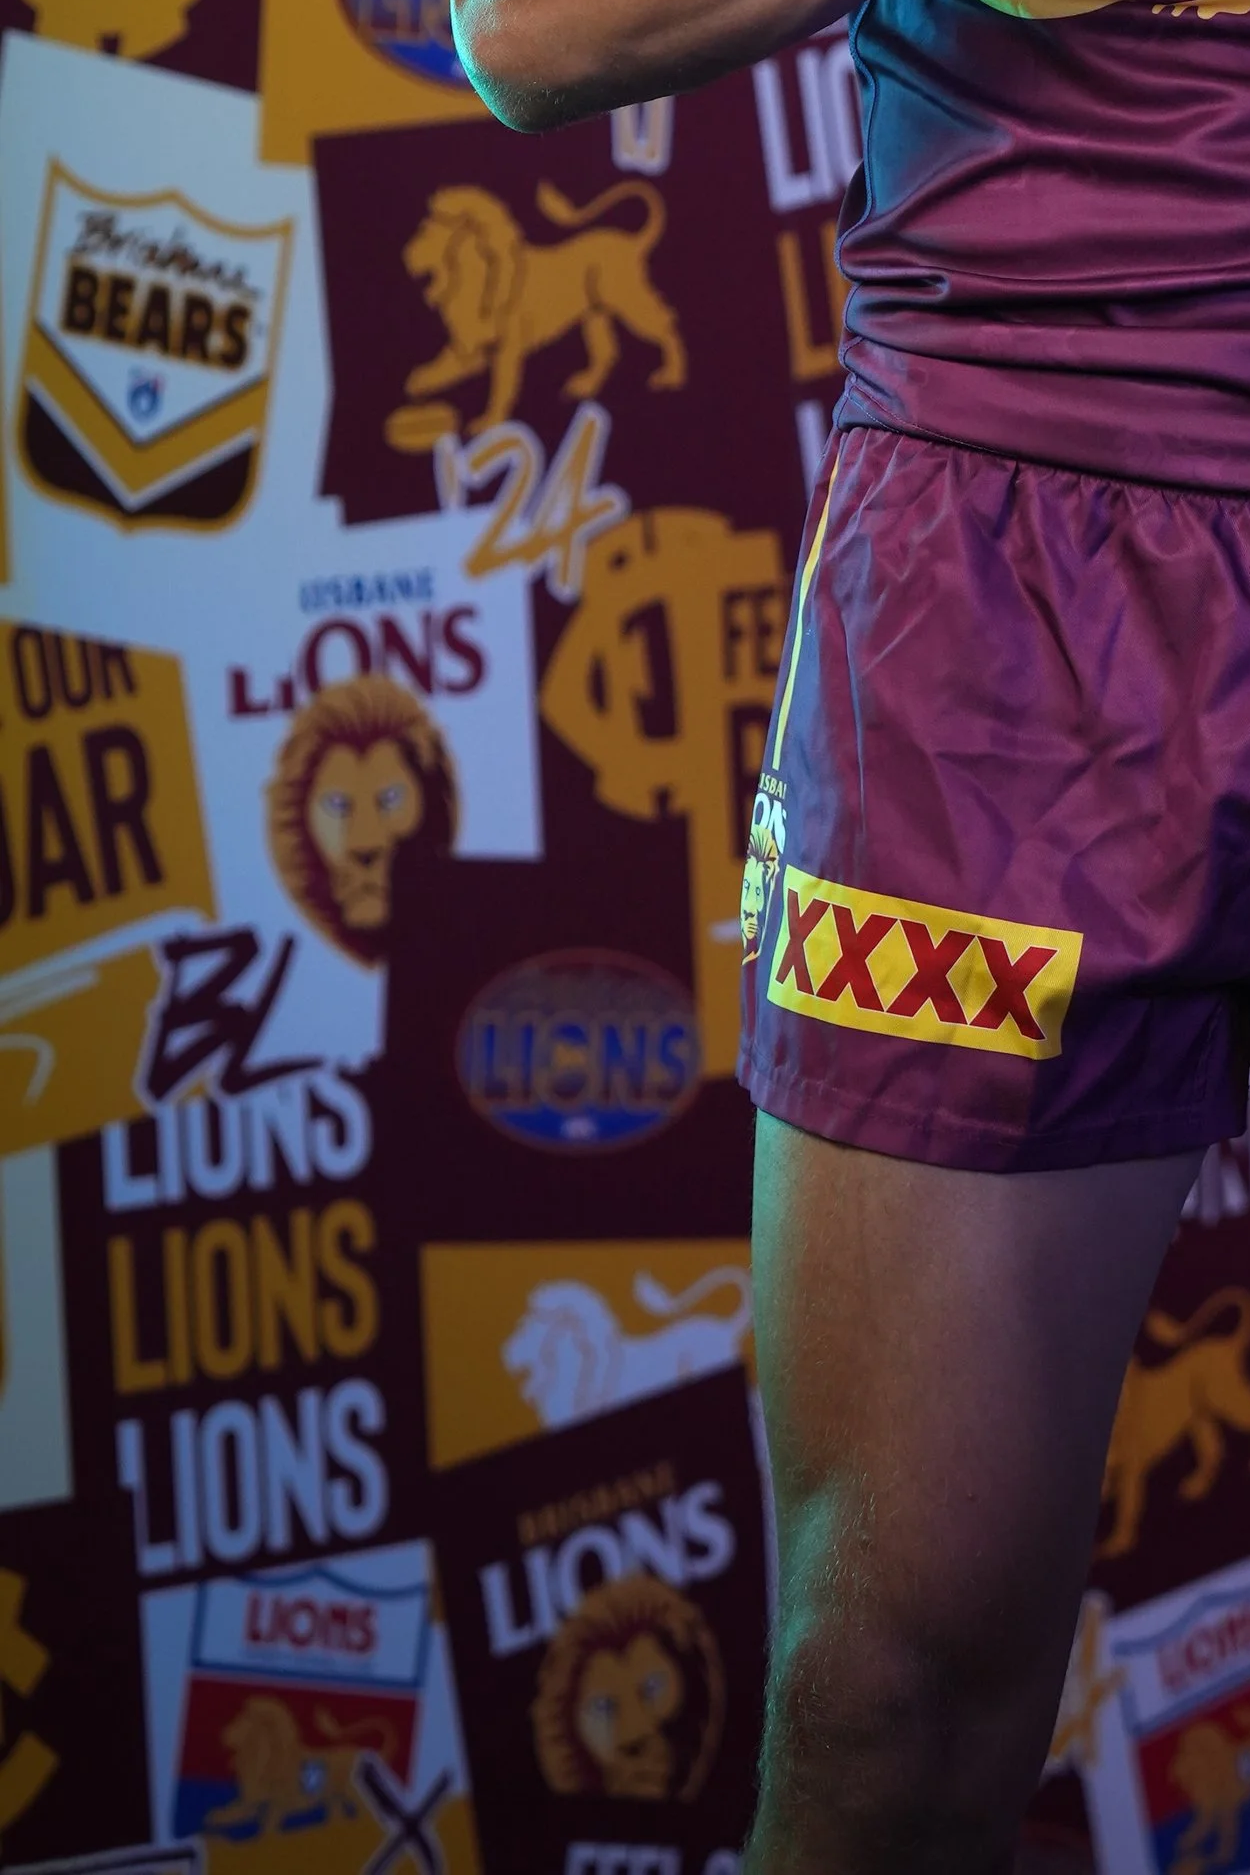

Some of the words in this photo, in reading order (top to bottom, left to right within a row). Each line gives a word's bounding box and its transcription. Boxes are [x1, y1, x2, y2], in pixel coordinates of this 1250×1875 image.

[60, 263, 254, 375] BEARS
[775, 888, 1057, 1042] XXXX
[465, 1005, 700, 1113] LIONS
[103, 1073, 373, 1213] LIONS
[107, 1198, 380, 1395] LIONS
[115, 1377, 392, 1578] LIONS
[243, 1590, 380, 1657] LIONS
[478, 1480, 736, 1658] LIONS
